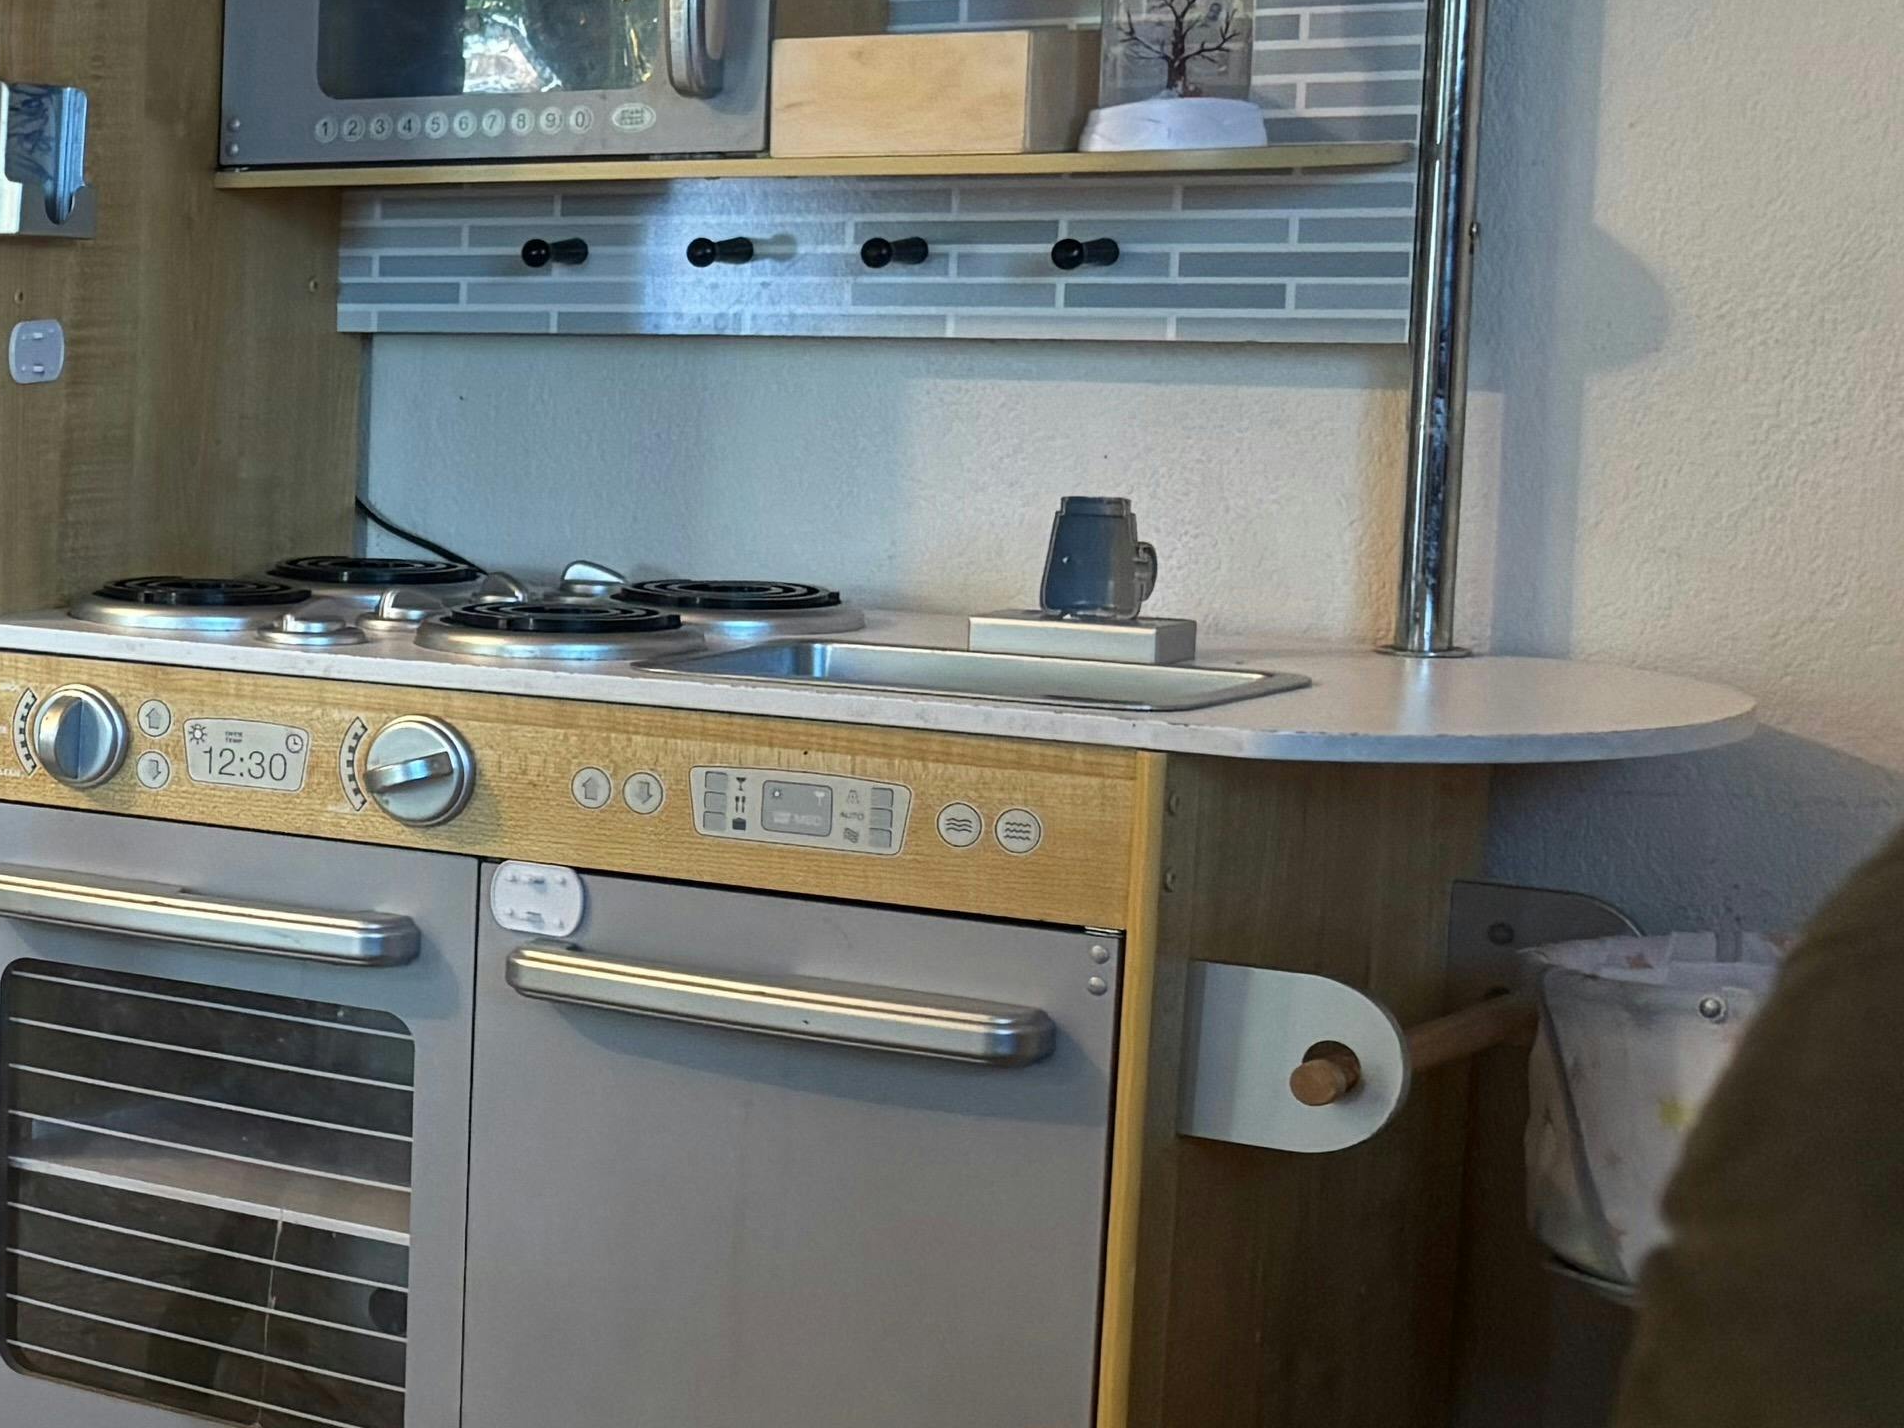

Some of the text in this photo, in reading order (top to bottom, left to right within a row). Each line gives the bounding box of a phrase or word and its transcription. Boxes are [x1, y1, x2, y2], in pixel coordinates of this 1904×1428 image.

[321, 110, 586, 137] 1 2 3 4 5 6 7 8 9 0
[202, 745, 288, 782] 12:30
